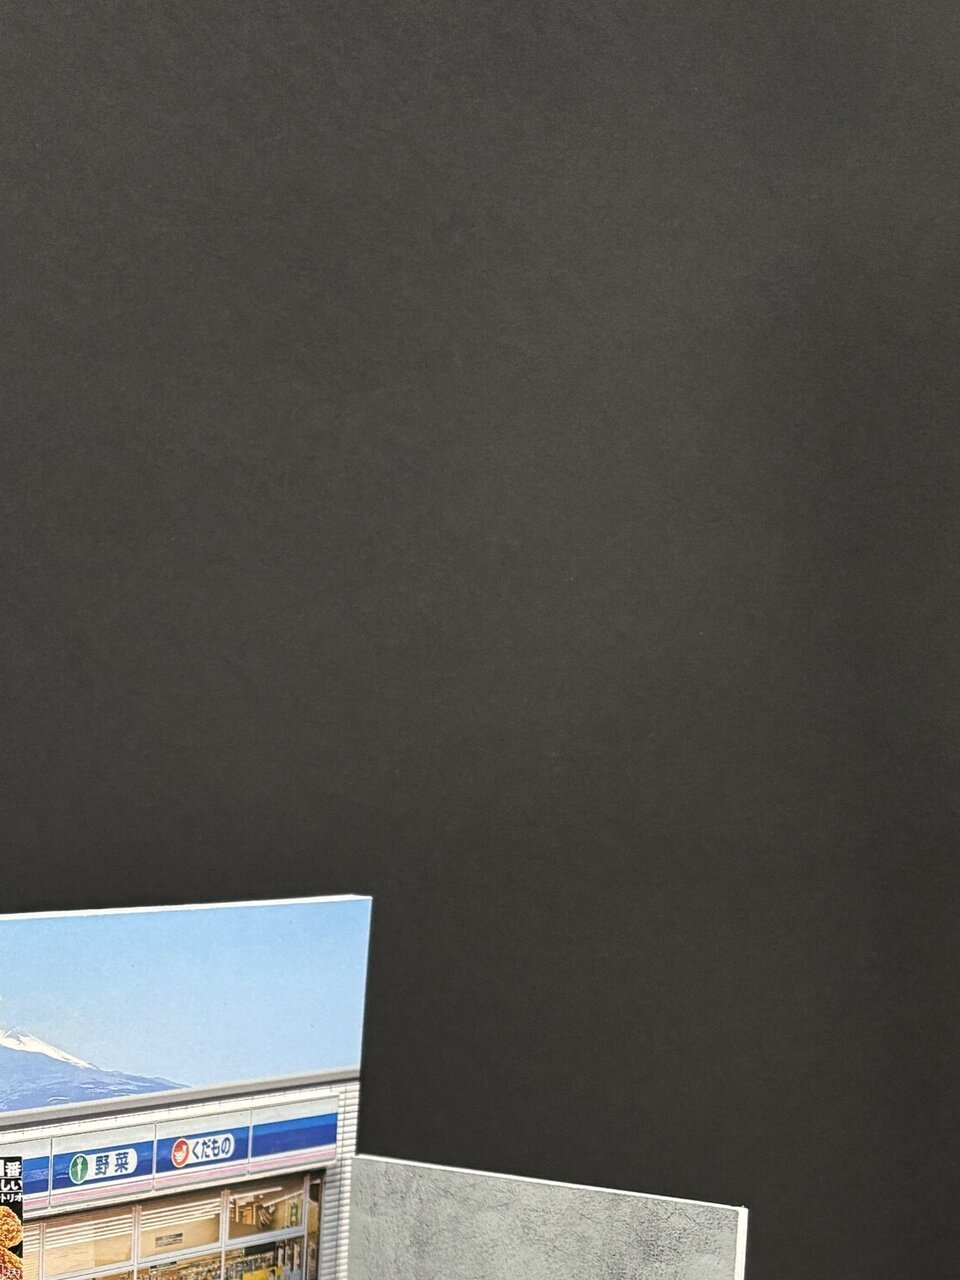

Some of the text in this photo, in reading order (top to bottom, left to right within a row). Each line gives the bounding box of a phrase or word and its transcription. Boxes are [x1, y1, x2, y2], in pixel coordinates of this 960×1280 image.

[192, 1137, 231, 1160] くだもの
[95, 1151, 129, 1176] 野菜
